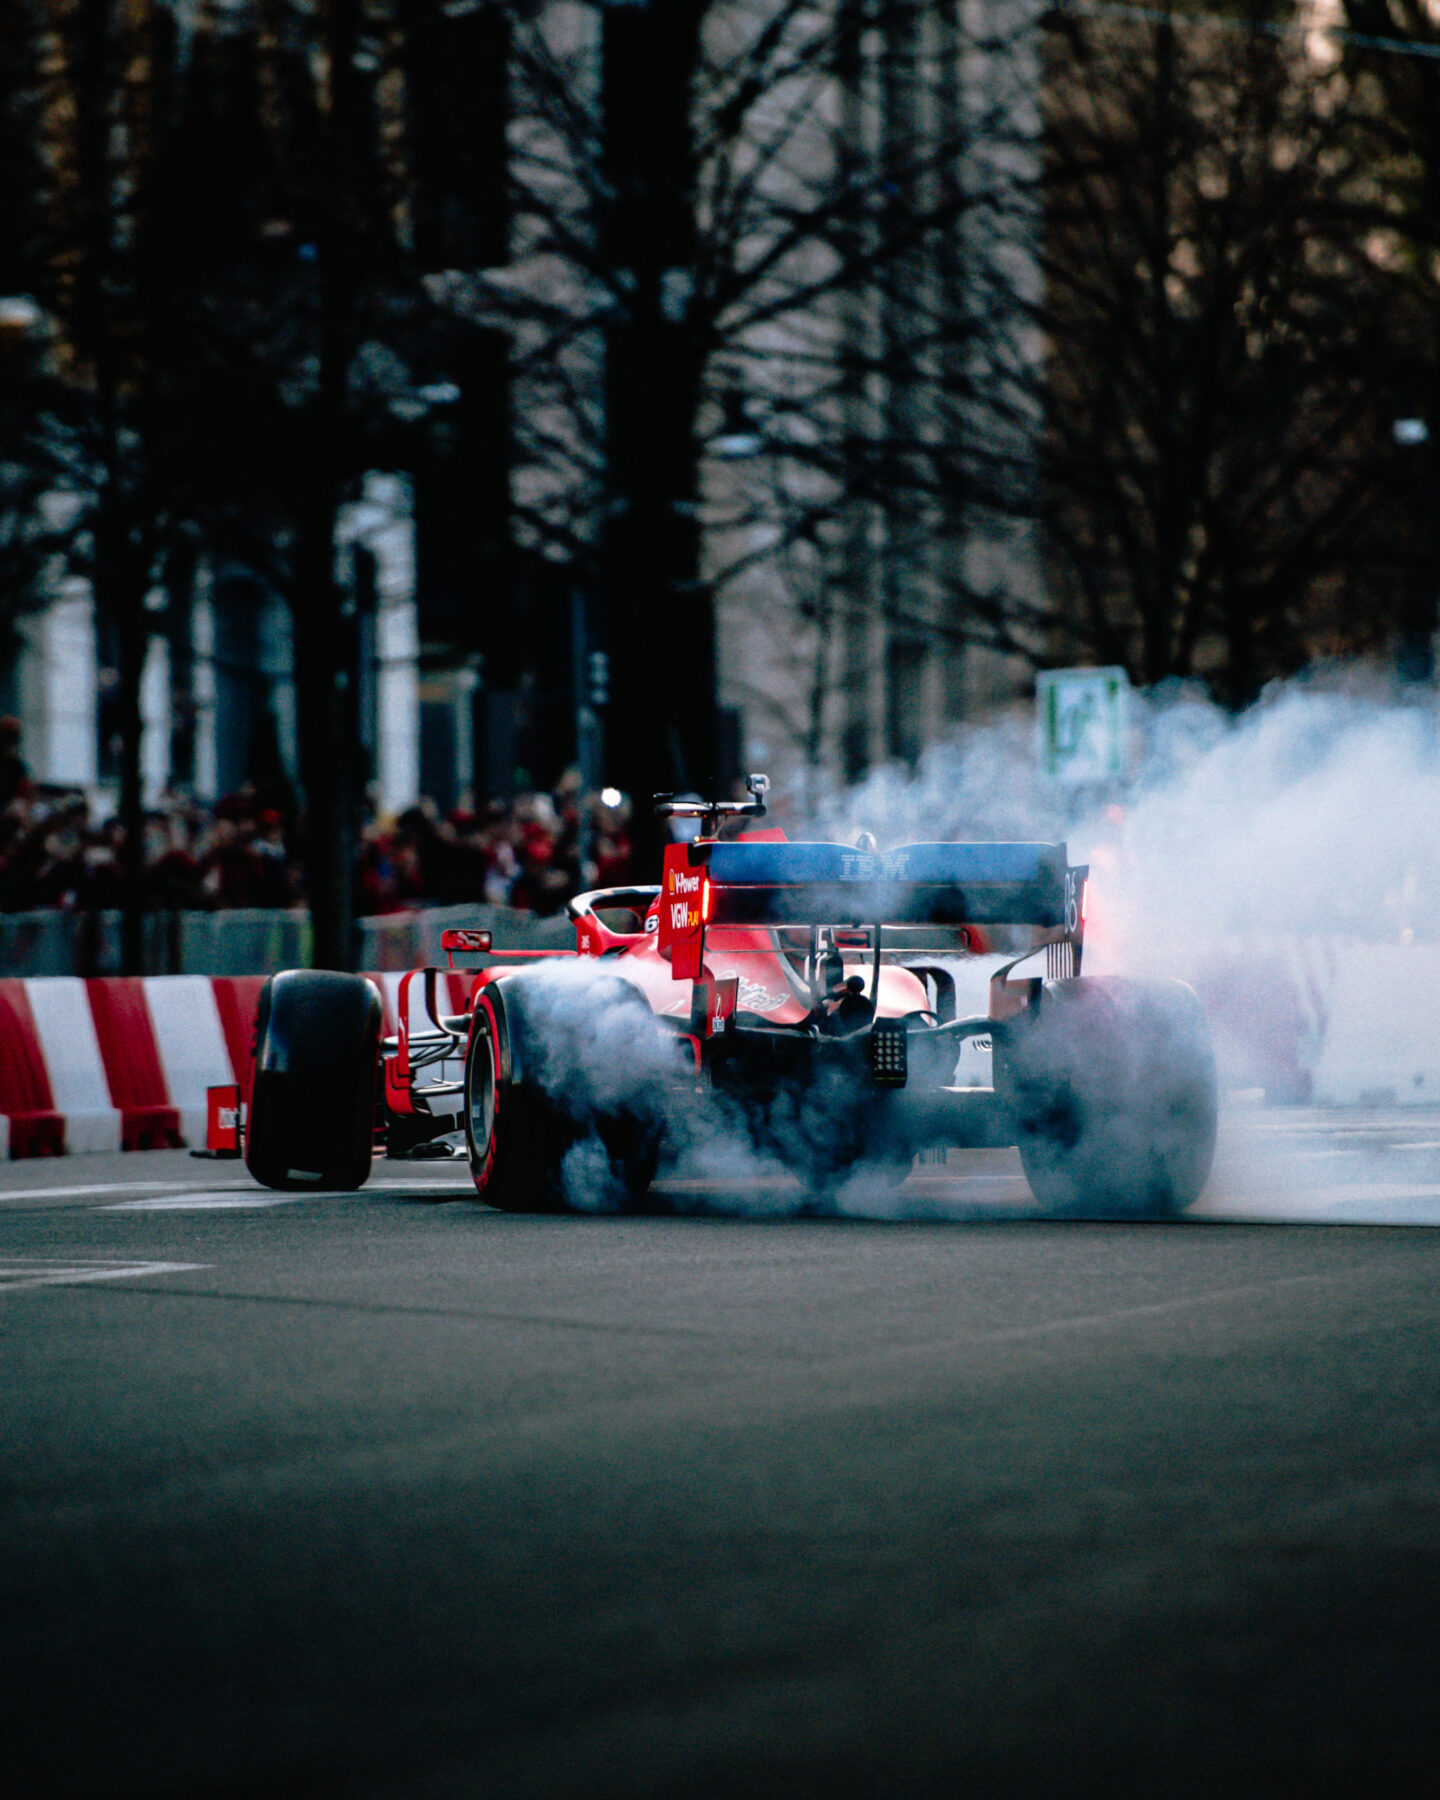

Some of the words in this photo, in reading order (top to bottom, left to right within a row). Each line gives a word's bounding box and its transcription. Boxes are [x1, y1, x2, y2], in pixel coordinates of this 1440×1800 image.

[839, 854, 910, 881] IBM
[674, 872, 700, 894] V-Power
[670, 902, 688, 930] VGW
